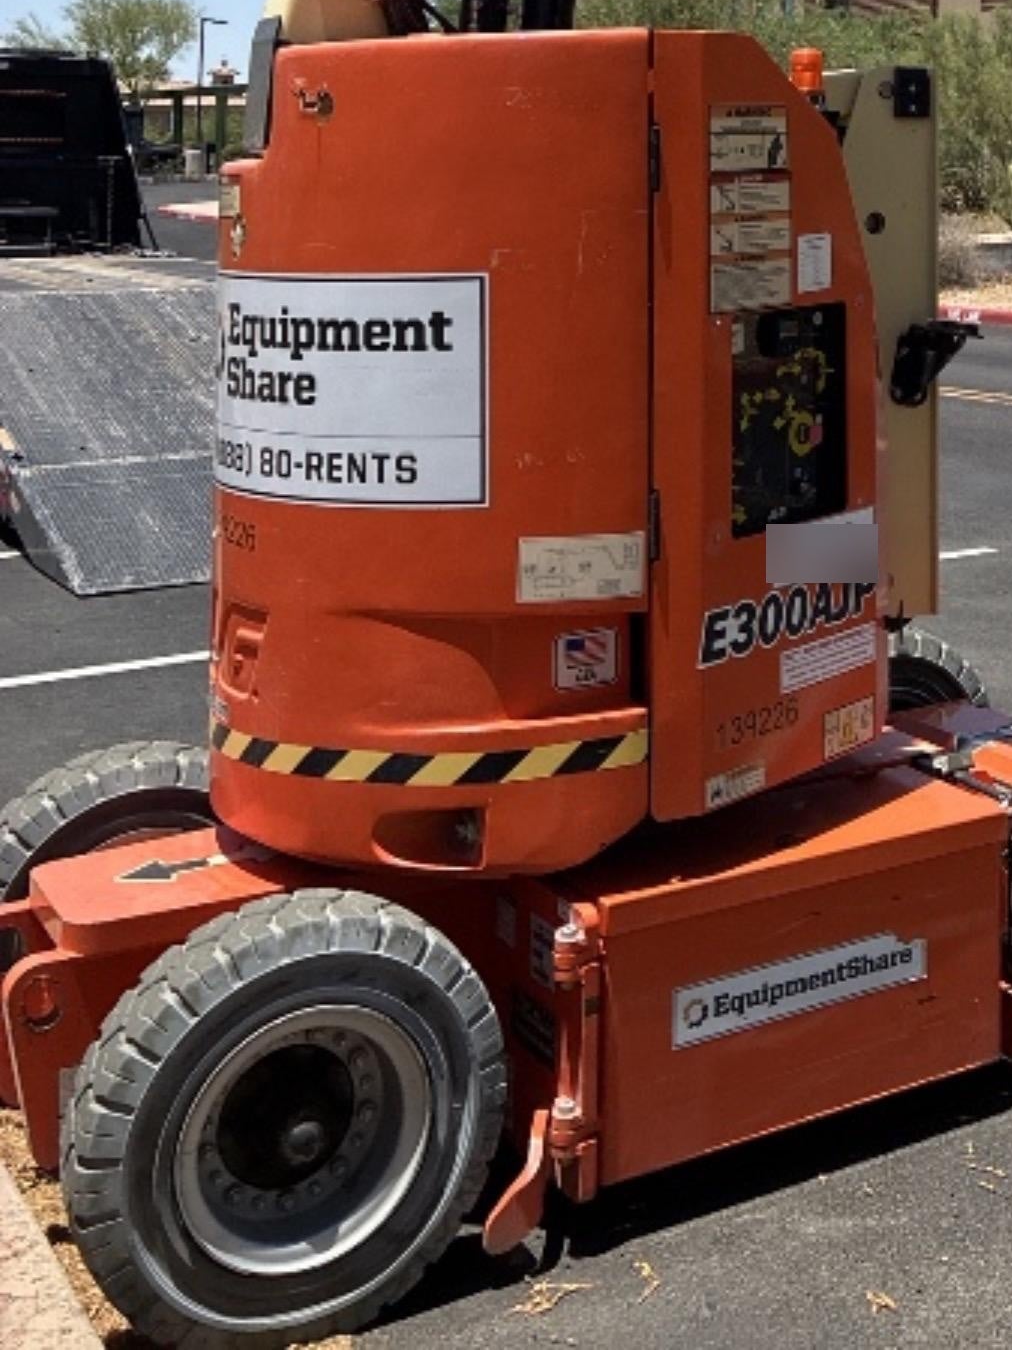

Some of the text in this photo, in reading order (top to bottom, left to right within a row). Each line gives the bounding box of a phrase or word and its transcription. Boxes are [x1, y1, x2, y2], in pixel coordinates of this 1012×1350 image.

[228, 302, 453, 361] Equipment
[227, 356, 317, 406] Share
[260, 446, 418, 485] 80-RENTS
[712, 946, 914, 1018] EquipmentShare
